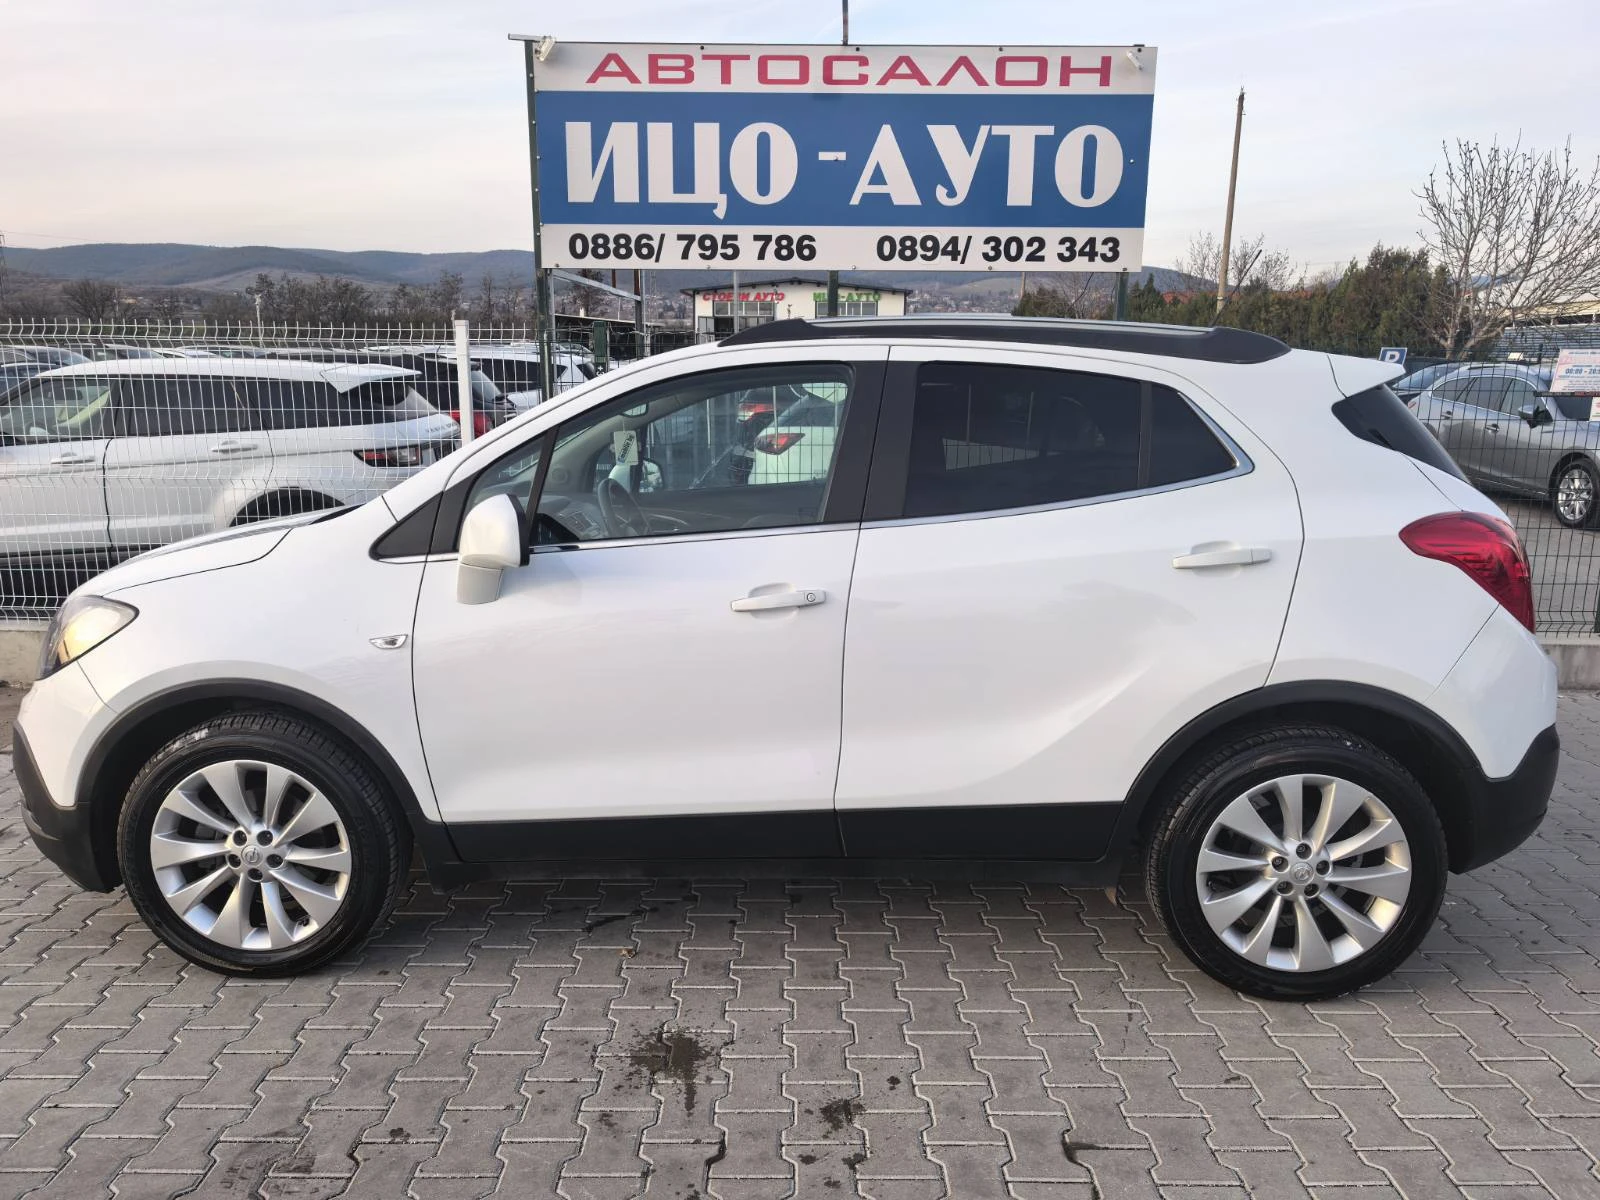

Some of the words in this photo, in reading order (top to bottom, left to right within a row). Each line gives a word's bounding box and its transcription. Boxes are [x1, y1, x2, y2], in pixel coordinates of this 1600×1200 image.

[586, 53, 1112, 87] АВТОСАЛОН
[569, 233, 666, 262] 0886/
[677, 234, 741, 260] 795
[753, 234, 817, 261] 786
[877, 235, 973, 264] 0894/
[982, 236, 1046, 262] 302
[1057, 236, 1120, 262] 343
